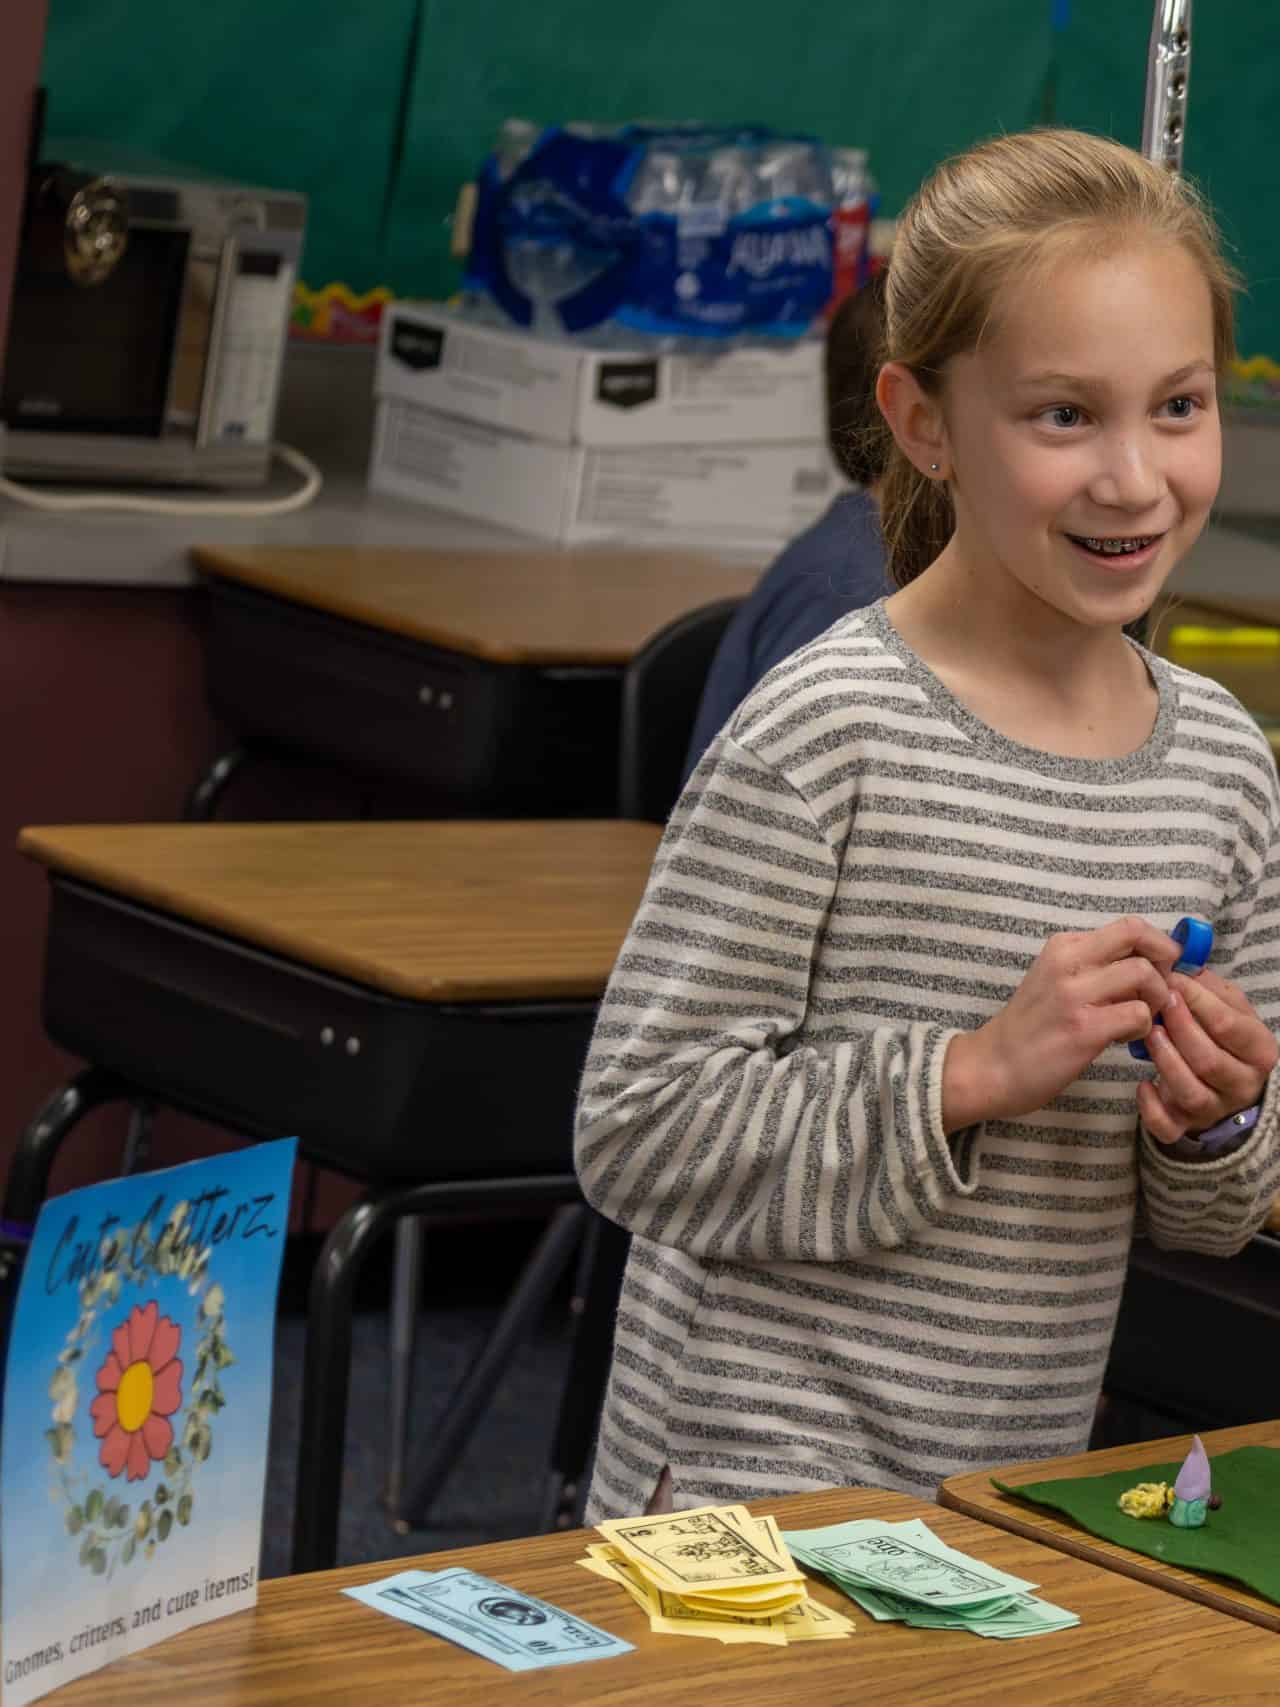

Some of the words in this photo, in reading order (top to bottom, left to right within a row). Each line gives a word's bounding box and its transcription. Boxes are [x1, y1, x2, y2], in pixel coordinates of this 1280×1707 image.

[46, 1214, 121, 1296] Cute
[129, 1184, 278, 1272] Critterz
[4, 1642, 64, 1685] Gnomes,
[69, 1616, 128, 1655] critters,
[132, 1599, 162, 1630] and
[166, 1588, 200, 1617] cute
[203, 1565, 256, 1602] items!
